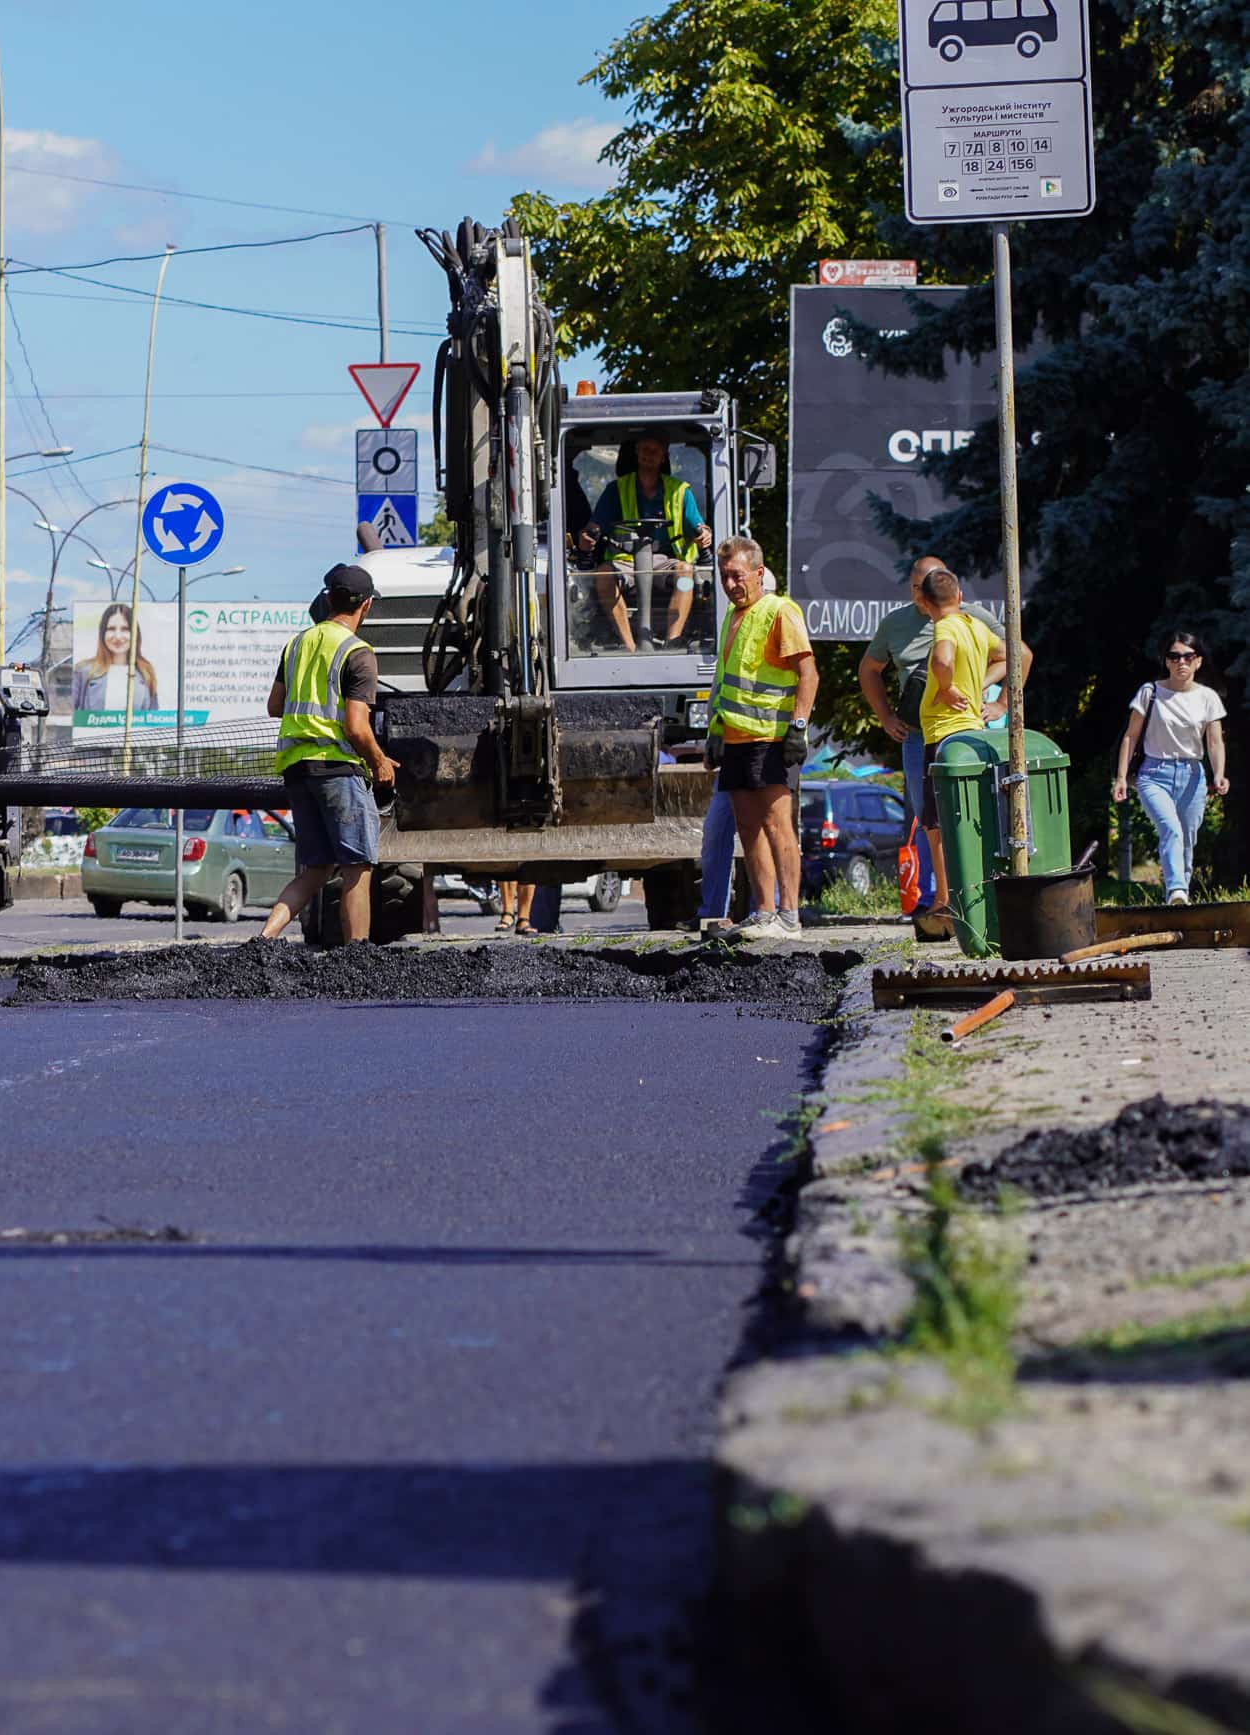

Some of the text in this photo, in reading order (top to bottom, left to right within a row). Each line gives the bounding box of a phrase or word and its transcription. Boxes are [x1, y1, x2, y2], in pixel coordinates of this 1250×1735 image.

[941, 101, 1052, 114] Ужгородський інститут
[949, 113, 993, 124] культури
[1000, 111, 1045, 120] мистецтв
[973, 129, 1022, 138] МАРШРУТИ
[948, 140, 1048, 156] 7 7Д 8 10 14
[965, 159, 1034, 172] 18 24 156
[216, 610, 311, 626] АСТРАМЕД
[806, 600, 892, 634] САМОЛІ
